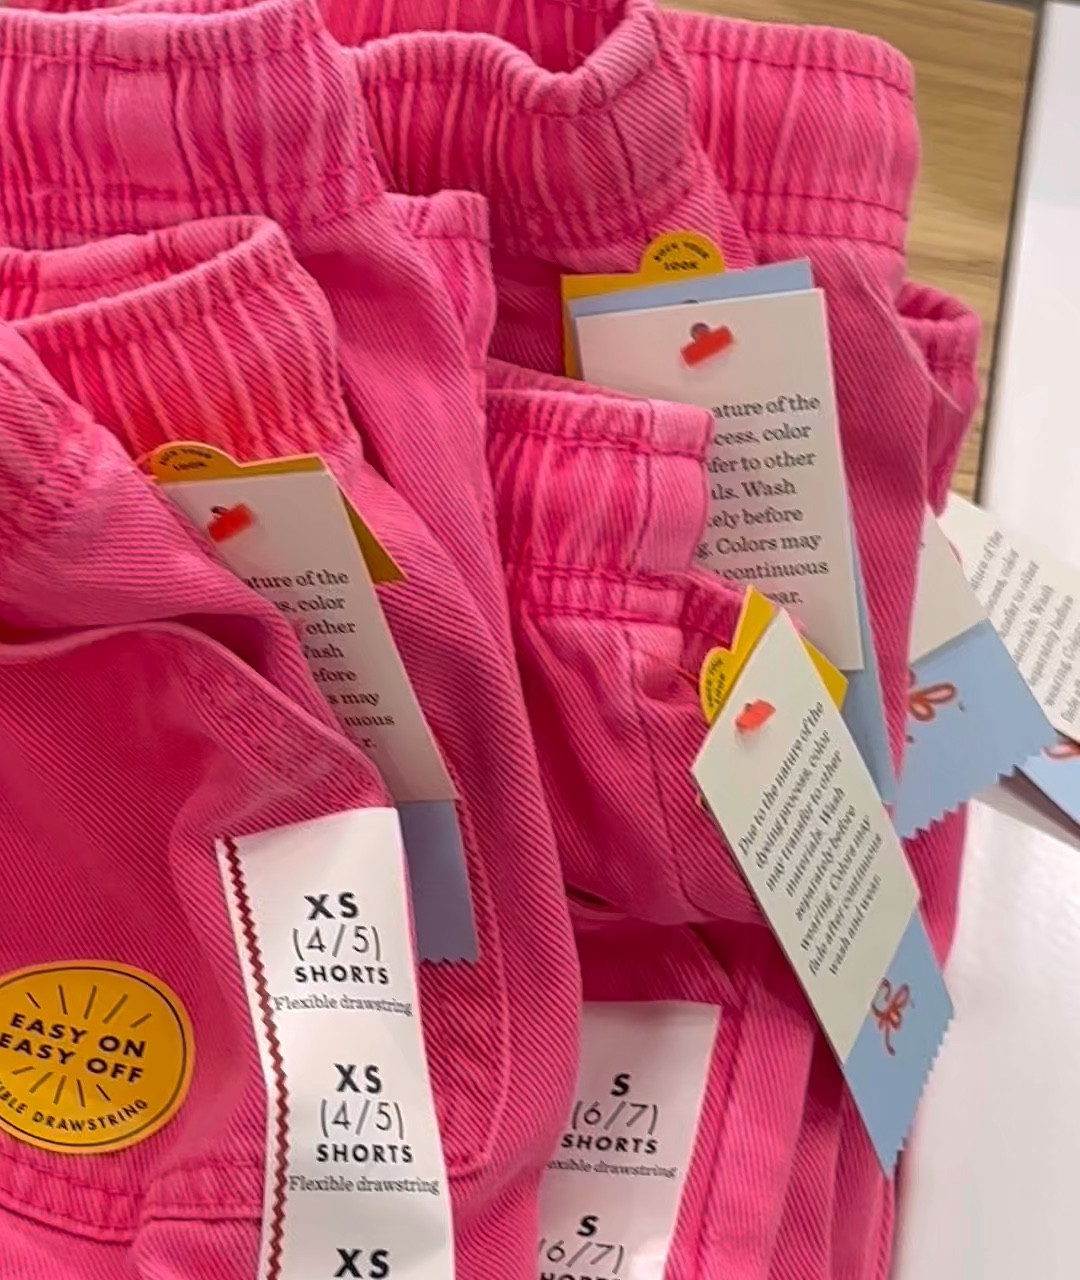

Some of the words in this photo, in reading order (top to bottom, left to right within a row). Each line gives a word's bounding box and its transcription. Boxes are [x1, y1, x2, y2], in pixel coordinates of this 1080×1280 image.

[711, 402, 762, 418] ature
[764, 394, 787, 414] of
[787, 393, 821, 412] the
[712, 430, 760, 447] cess,
[762, 422, 813, 442] color
[740, 456, 762, 472] to
[763, 450, 816, 470] other
[740, 478, 797, 498] Wash
[741, 505, 803, 526] before
[716, 535, 777, 555] Colors
[780, 534, 821, 552] may
[295, 569, 316, 587] of
[316, 568, 350, 586] the
[722, 561, 830, 581] continuous
[298, 594, 347, 612] color
[762, 591, 803, 605] ear.
[305, 619, 357, 635] other
[311, 666, 358, 682] efore
[340, 691, 380, 708] may
[806, 701, 825, 728] the
[800, 718, 813, 742] of
[775, 738, 803, 788] nature
[756, 817, 784, 869] dyeing
[808, 729, 831, 768] color
[761, 783, 779, 811] the
[818, 786, 846, 826] Wash
[752, 807, 766, 827] to
[765, 855, 786, 893] may
[780, 801, 814, 861] transfer
[809, 787, 823, 806] to
[819, 748, 843, 791] other
[737, 823, 758, 856] Due
[794, 846, 835, 922] separately
[828, 804, 856, 850] before
[829, 844, 857, 892] Colors
[852, 814, 872, 849] may
[304, 892, 359, 920] XS
[808, 943, 828, 977] fade
[824, 907, 845, 946] after
[842, 832, 883, 911] continuous
[293, 924, 382, 962] (4/5)
[828, 935, 852, 977] wash
[847, 904, 865, 940] and
[295, 965, 389, 985] SHORTS
[273, 995, 338, 1011] Flexible
[340, 996, 414, 1018] drawstring
[9, 1012, 88, 1044] EASY
[98, 1035, 147, 1058] ON
[86, 1057, 144, 1084] OFF
[334, 1063, 382, 1094] XS
[610, 1073, 631, 1097] S
[32, 1098, 149, 1132] DRAWSTRING
[321, 1099, 404, 1141] (4/5)
[572, 1100, 659, 1135] (6/7)
[316, 1144, 414, 1164] SHORTS
[560, 1132, 659, 1154] SHORTS
[547, 1159, 592, 1172] exible
[593, 1161, 678, 1179] drawstring
[288, 1175, 354, 1192] Flexible
[356, 1177, 440, 1196] drawstring
[577, 1215, 599, 1238] S
[334, 1248, 391, 1280] XS
